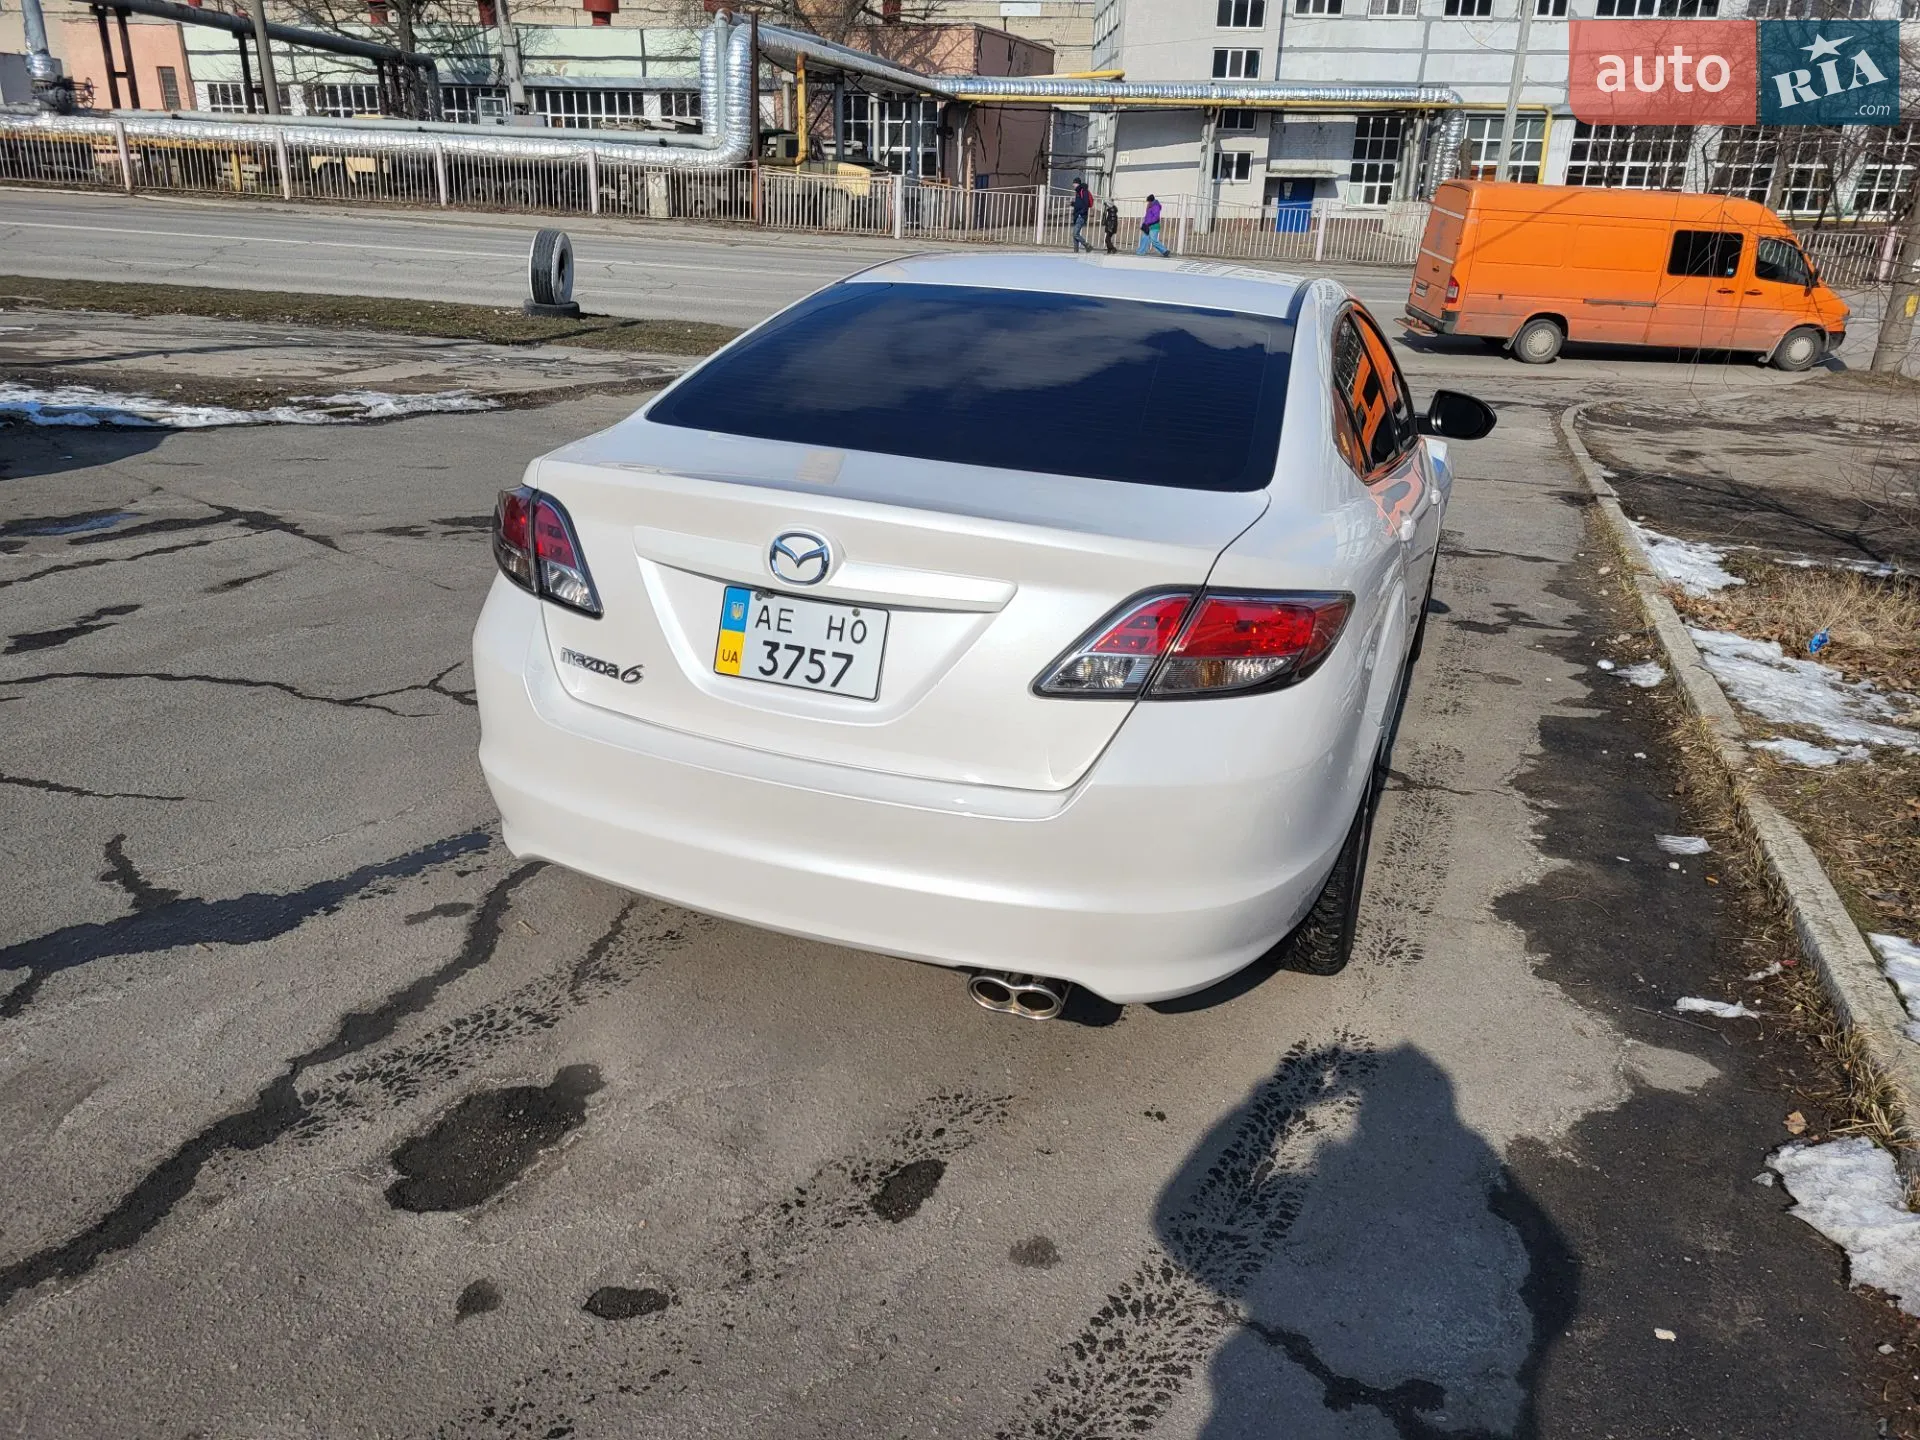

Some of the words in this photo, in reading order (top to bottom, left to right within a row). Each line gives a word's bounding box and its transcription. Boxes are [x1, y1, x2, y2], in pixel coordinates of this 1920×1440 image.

[754, 605, 795, 634] AE
[826, 614, 867, 645] HO
[722, 648, 739, 664] UA
[758, 640, 854, 688] 3757
